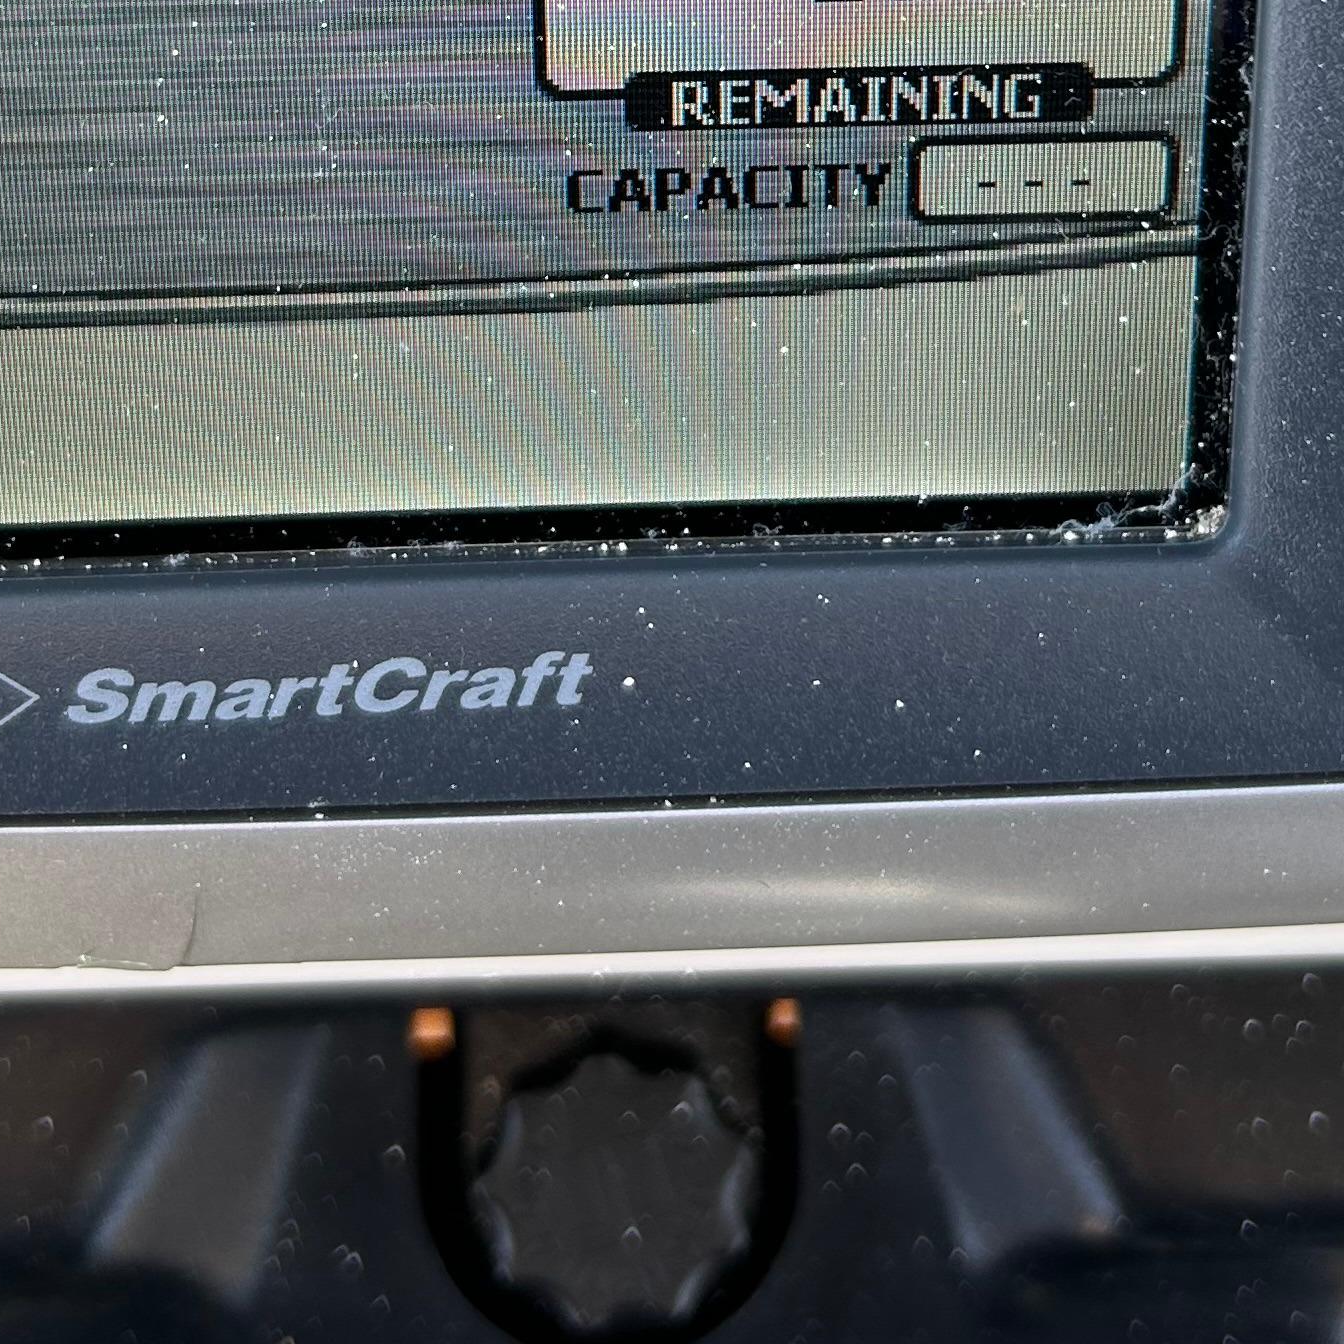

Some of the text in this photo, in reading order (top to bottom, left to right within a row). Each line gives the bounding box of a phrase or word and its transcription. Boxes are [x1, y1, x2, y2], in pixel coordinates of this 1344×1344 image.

[670, 72, 1044, 127] REMAINING
[566, 163, 892, 213] CAPACITY
[66, 651, 594, 724] SmartCraft
